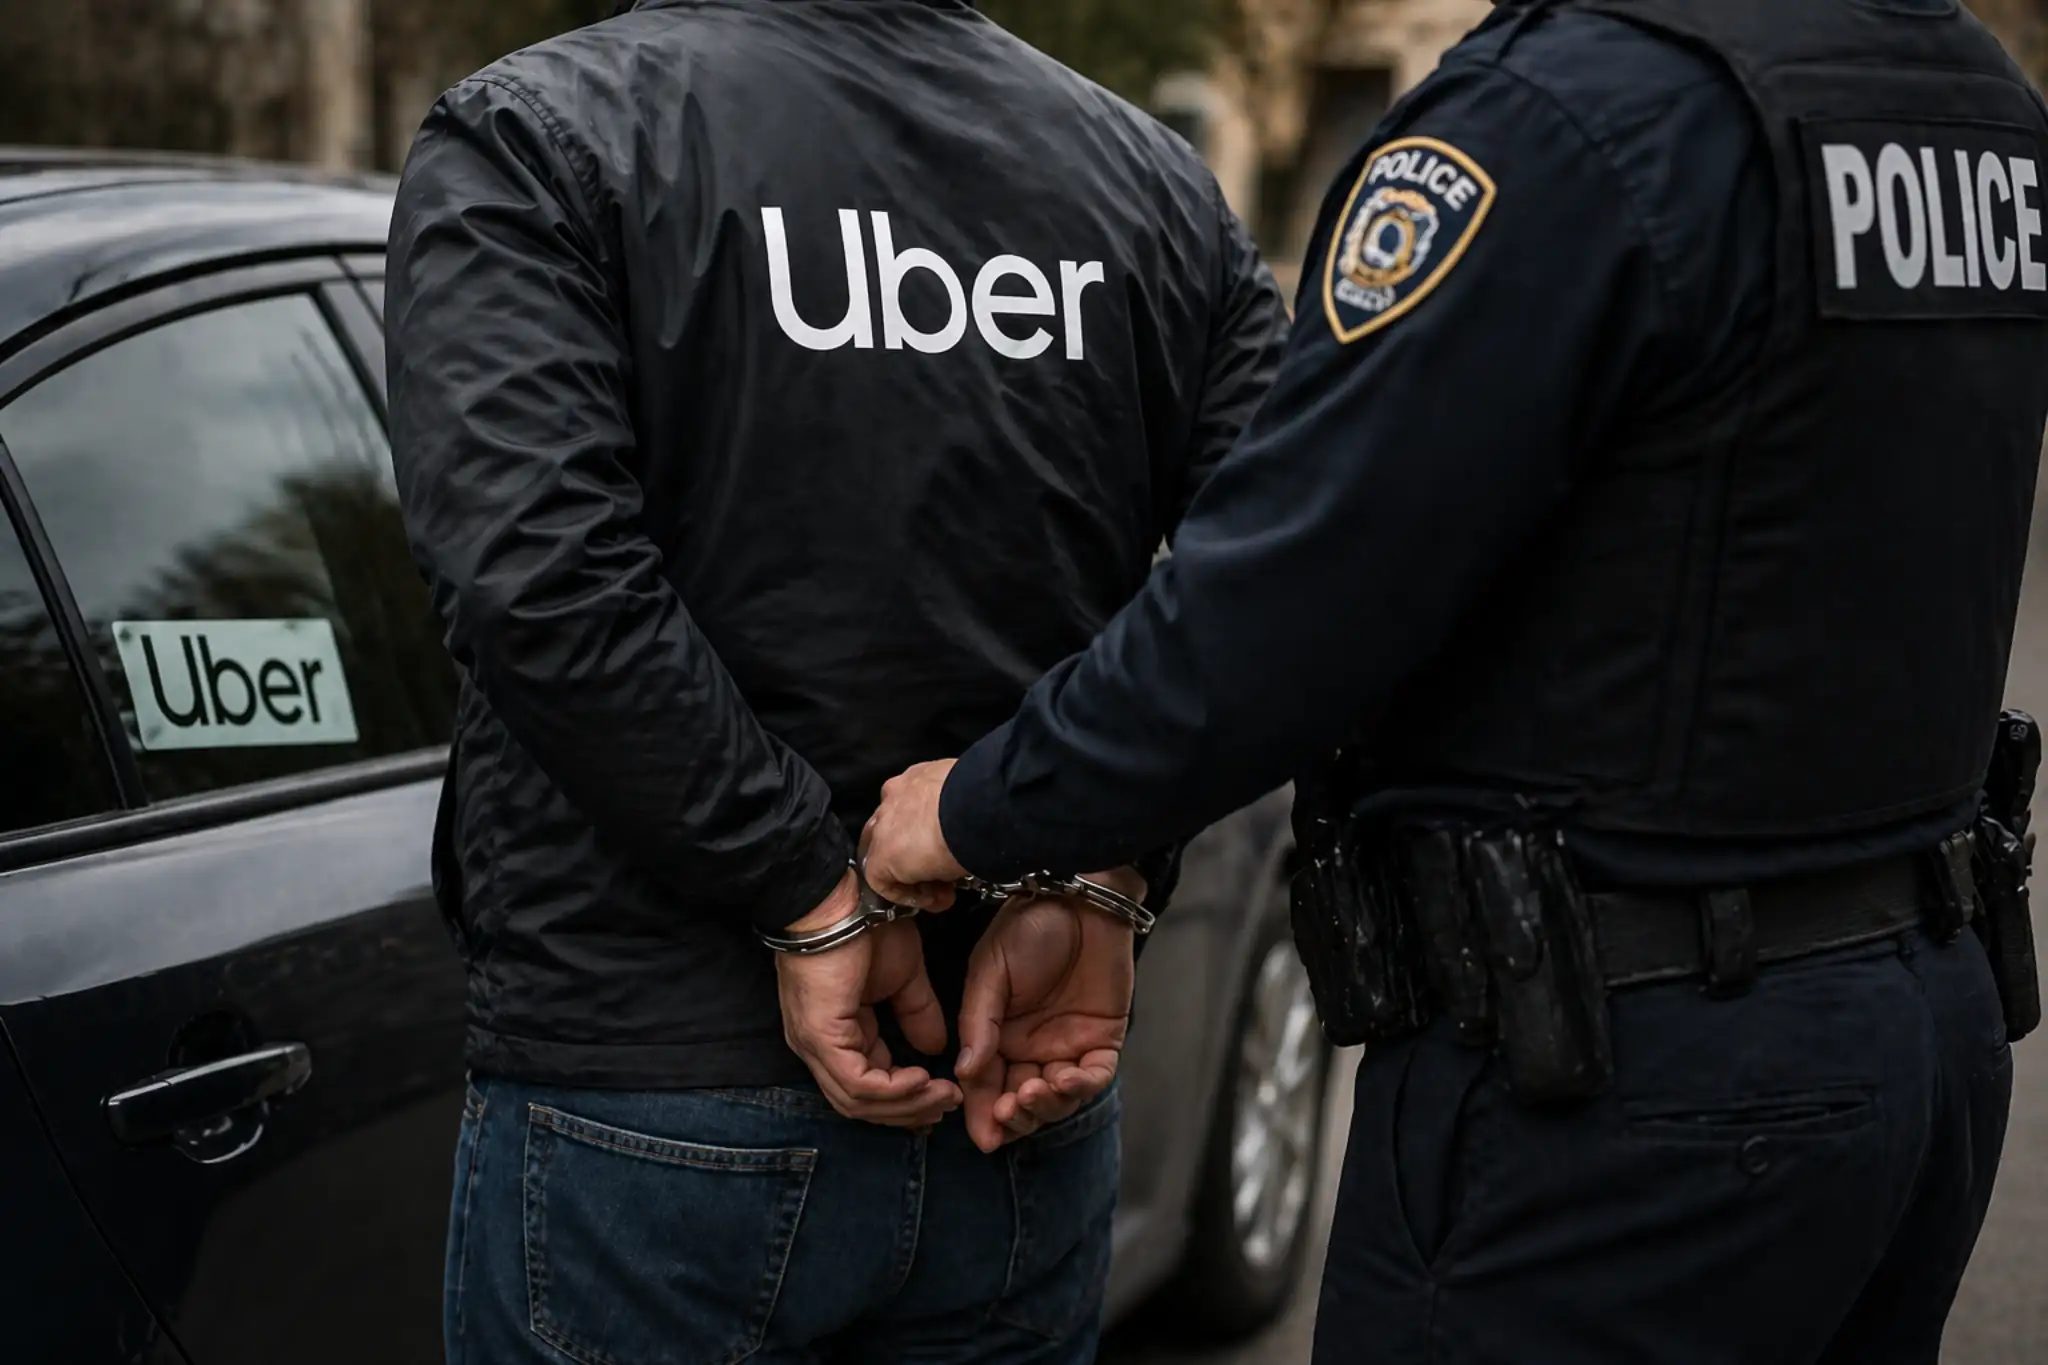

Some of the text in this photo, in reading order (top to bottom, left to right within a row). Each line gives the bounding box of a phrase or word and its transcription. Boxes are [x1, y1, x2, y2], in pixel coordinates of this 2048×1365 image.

[1368, 150, 1478, 212] POLICE
[1821, 142, 2047, 291] POLICE
[761, 206, 1105, 360] Uber
[140, 634, 323, 728] Uber
